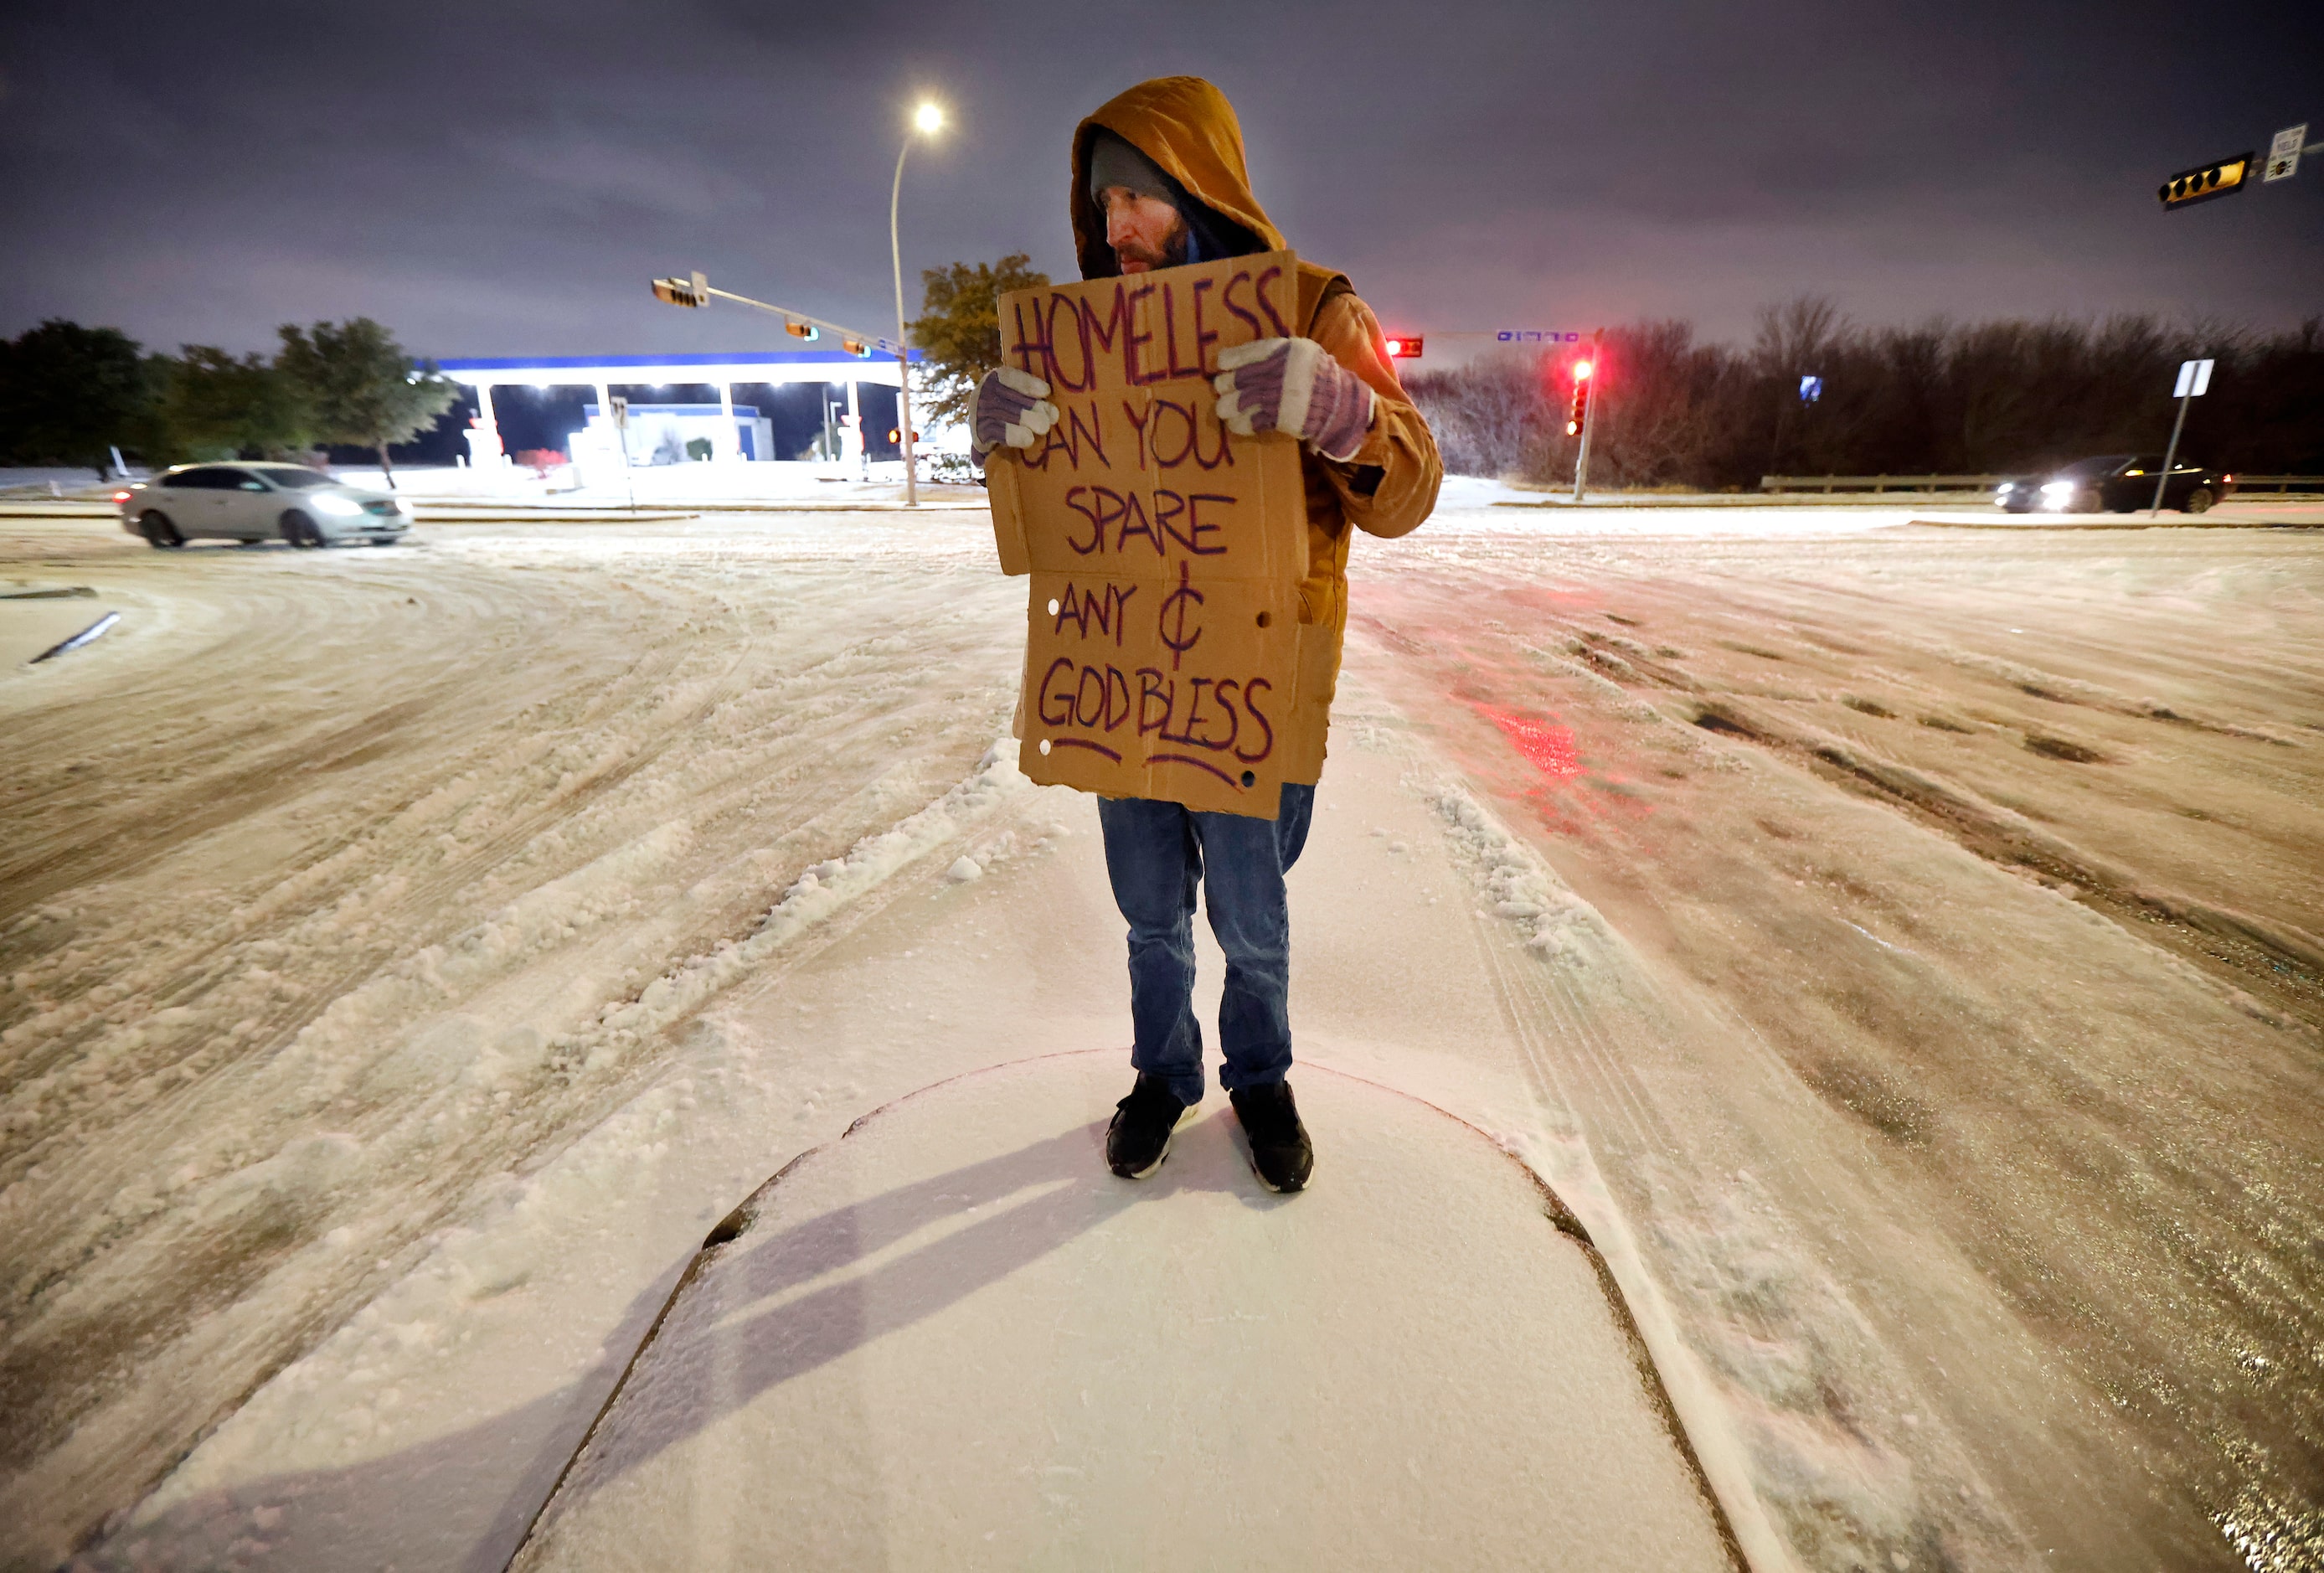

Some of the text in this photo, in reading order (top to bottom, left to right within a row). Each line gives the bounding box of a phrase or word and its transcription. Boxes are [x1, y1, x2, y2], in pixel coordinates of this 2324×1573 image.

[1012, 266, 1291, 394] HOMELESS
[1122, 400, 1235, 471] YOU
[1065, 485, 1238, 556] SPARE
[1055, 581, 1137, 647] ANY
[1038, 657, 1273, 764] GOD BLESS
